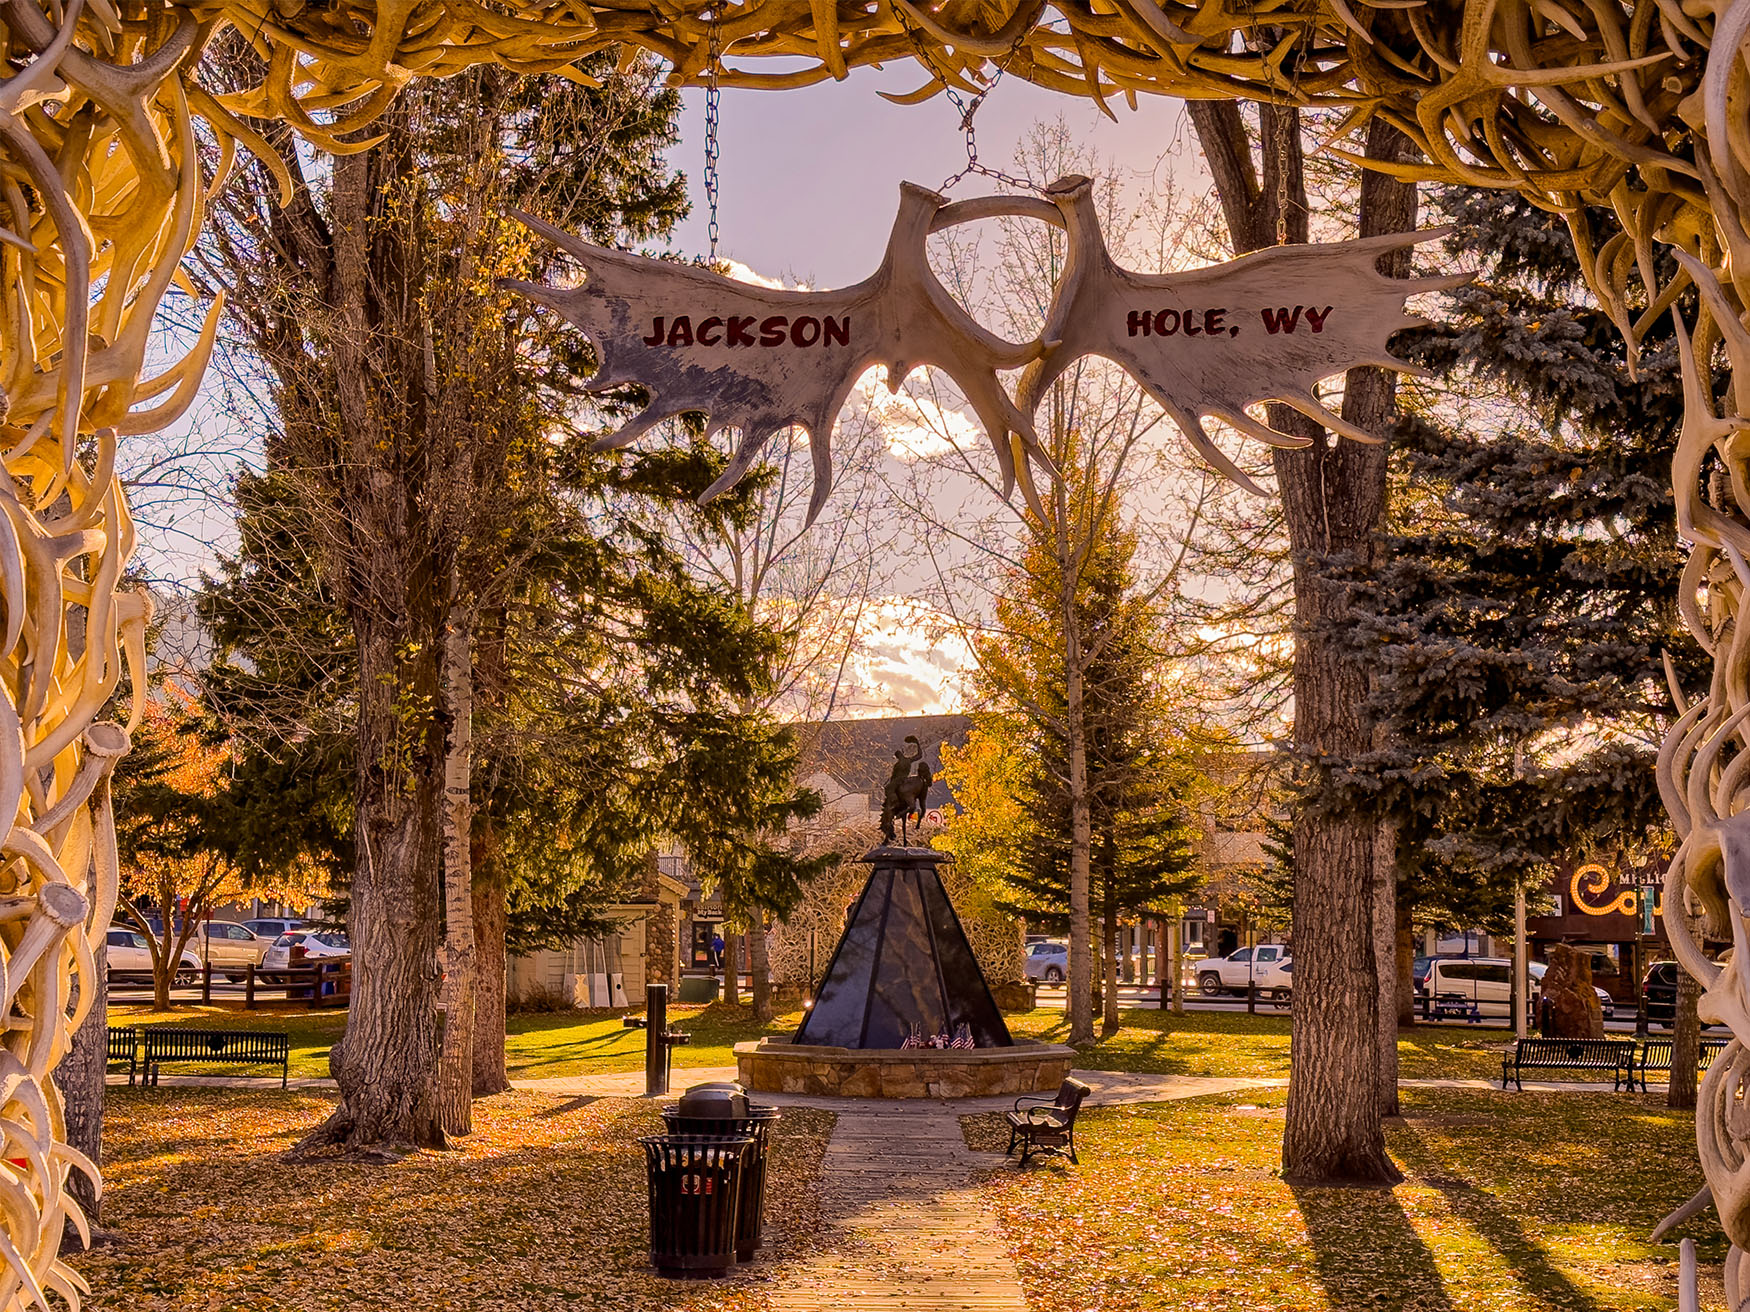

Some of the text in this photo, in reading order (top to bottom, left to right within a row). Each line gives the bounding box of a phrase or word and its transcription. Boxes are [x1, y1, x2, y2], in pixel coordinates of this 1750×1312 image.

[642, 305, 1334, 348] JACKSON HOLE, WY
